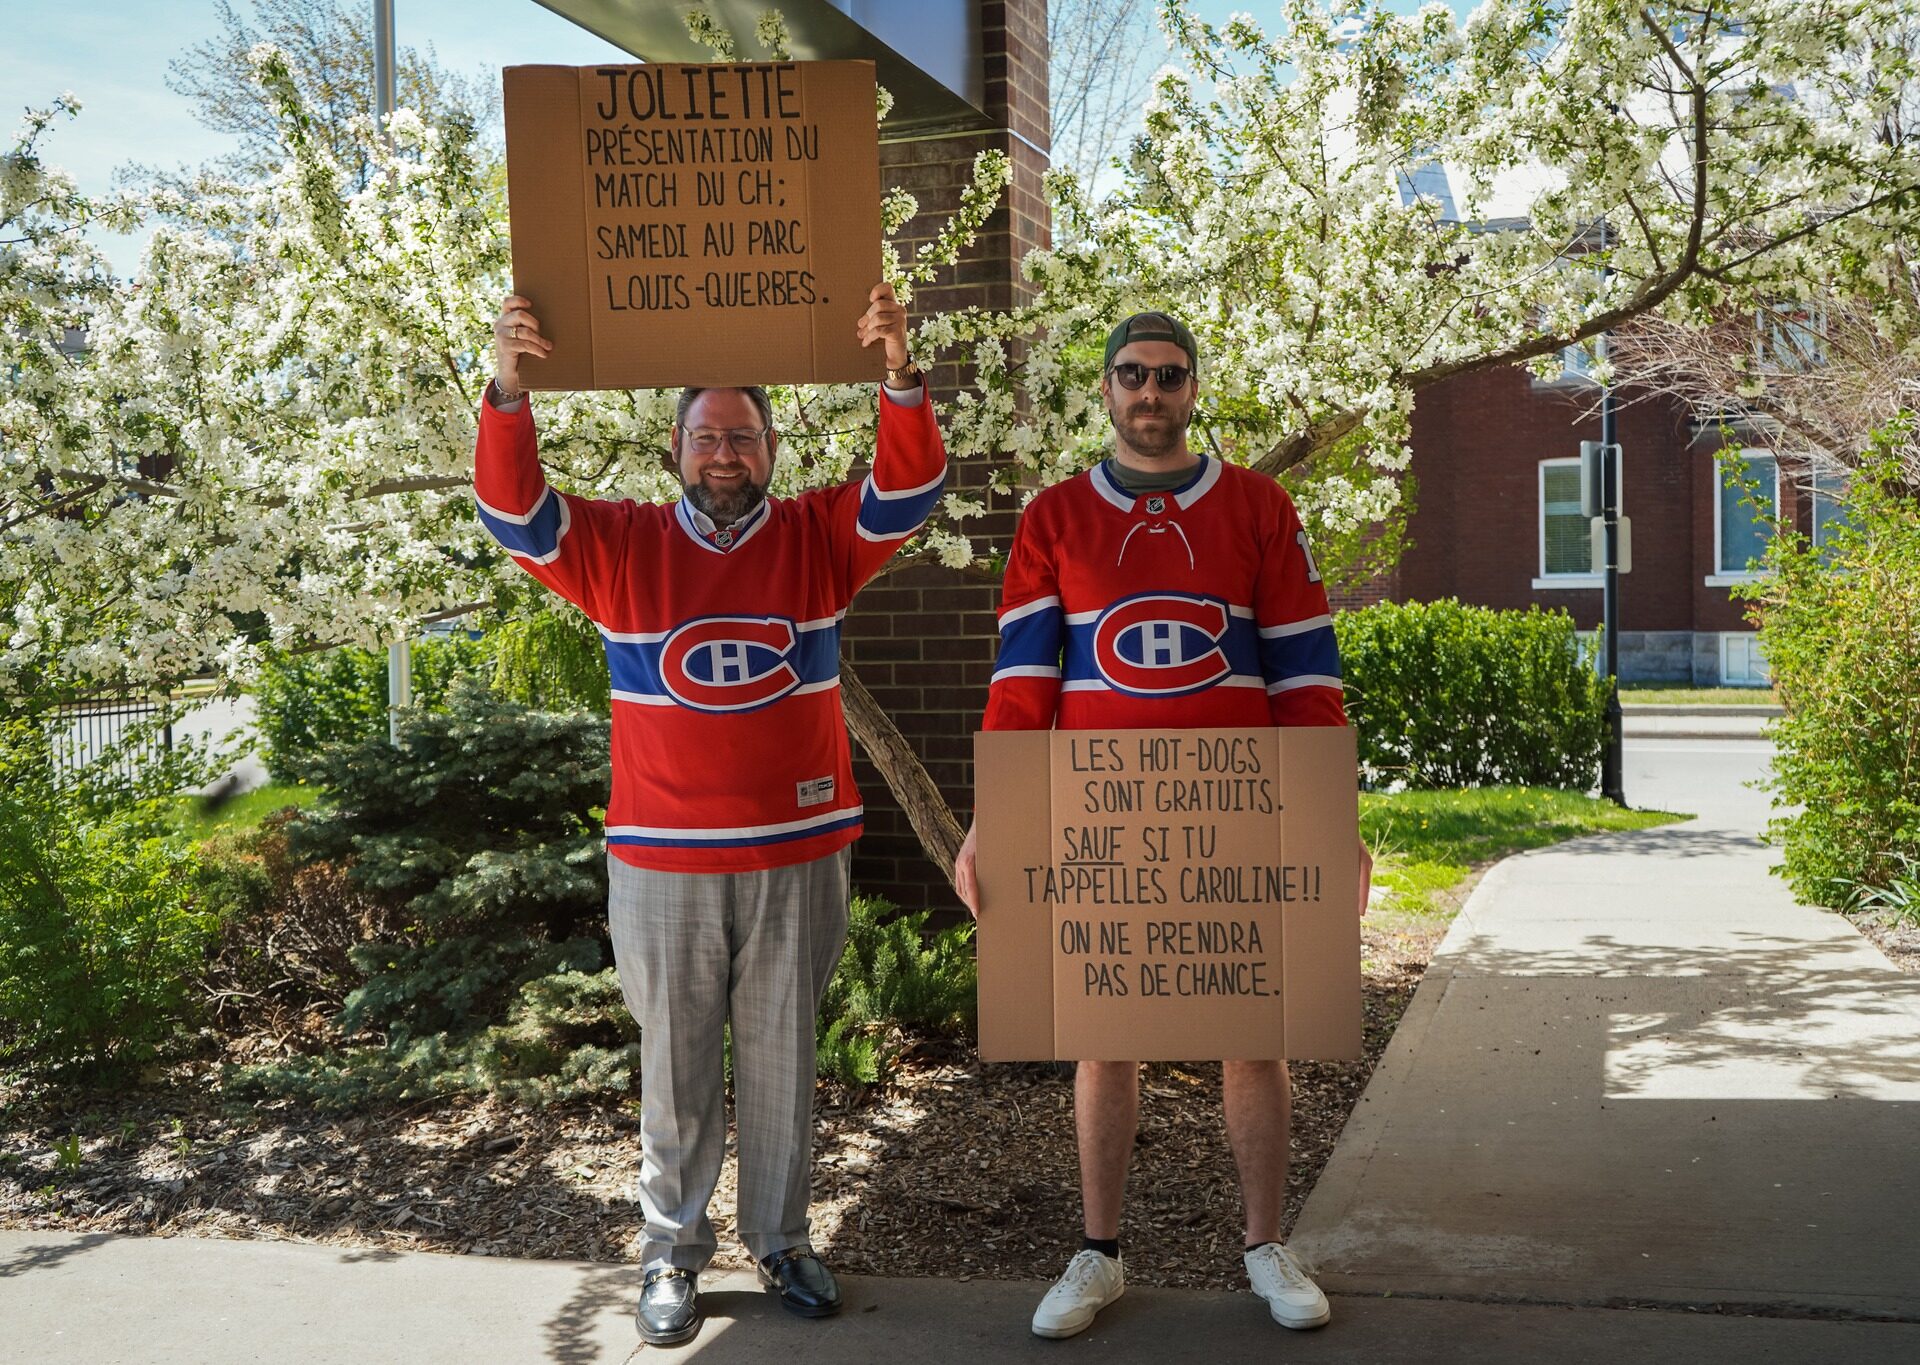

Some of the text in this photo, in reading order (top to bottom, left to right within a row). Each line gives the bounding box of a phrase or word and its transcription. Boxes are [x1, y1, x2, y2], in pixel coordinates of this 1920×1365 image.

[597, 64, 801, 121] JOLIETTE
[587, 124, 818, 165] PRÉSENTATION DU
[595, 169, 785, 208] MATCH DU CH;
[597, 220, 805, 259] SAMEDI AU PARC
[607, 271, 829, 310] LOUIS-QUERBES.
[1072, 737, 1261, 774] LES HOT-DOGS
[1085, 779, 1284, 814] SONT GRATUITS.
[1064, 825, 1215, 862] SAUF SI TU
[1024, 865, 1321, 904] T'APPELLES CAROLINE!!
[1061, 920, 1263, 954] ON NE PRENDRA
[1085, 962, 1280, 996] PAS DE CHANCE.
